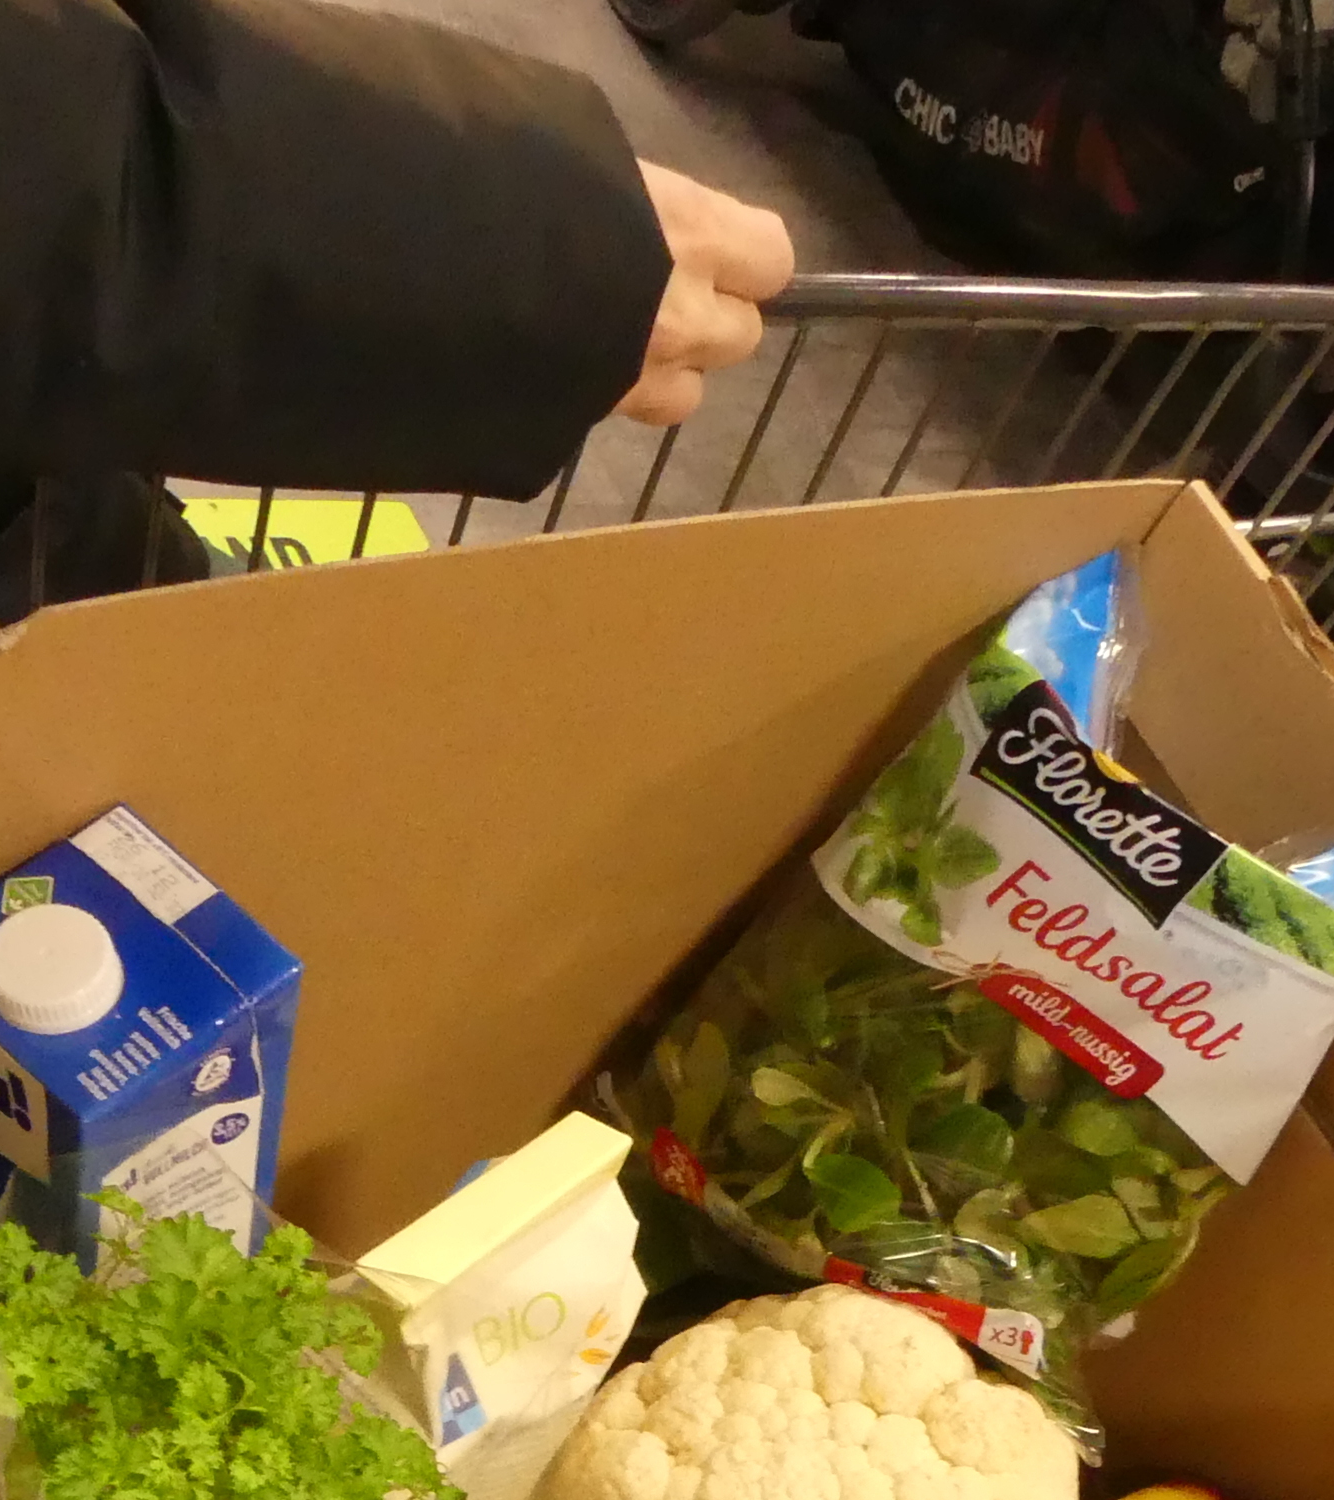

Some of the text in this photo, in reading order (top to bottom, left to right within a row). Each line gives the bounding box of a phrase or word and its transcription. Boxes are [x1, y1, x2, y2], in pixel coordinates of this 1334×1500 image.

[895, 77, 957, 145] CHIC
[983, 114, 1044, 166] BABY
[997, 707, 1182, 887] Florette
[985, 859, 1244, 1061] Feldsalat
[1007, 983, 1137, 1087] mild-nussig
[472, 1290, 567, 1366] BIO
